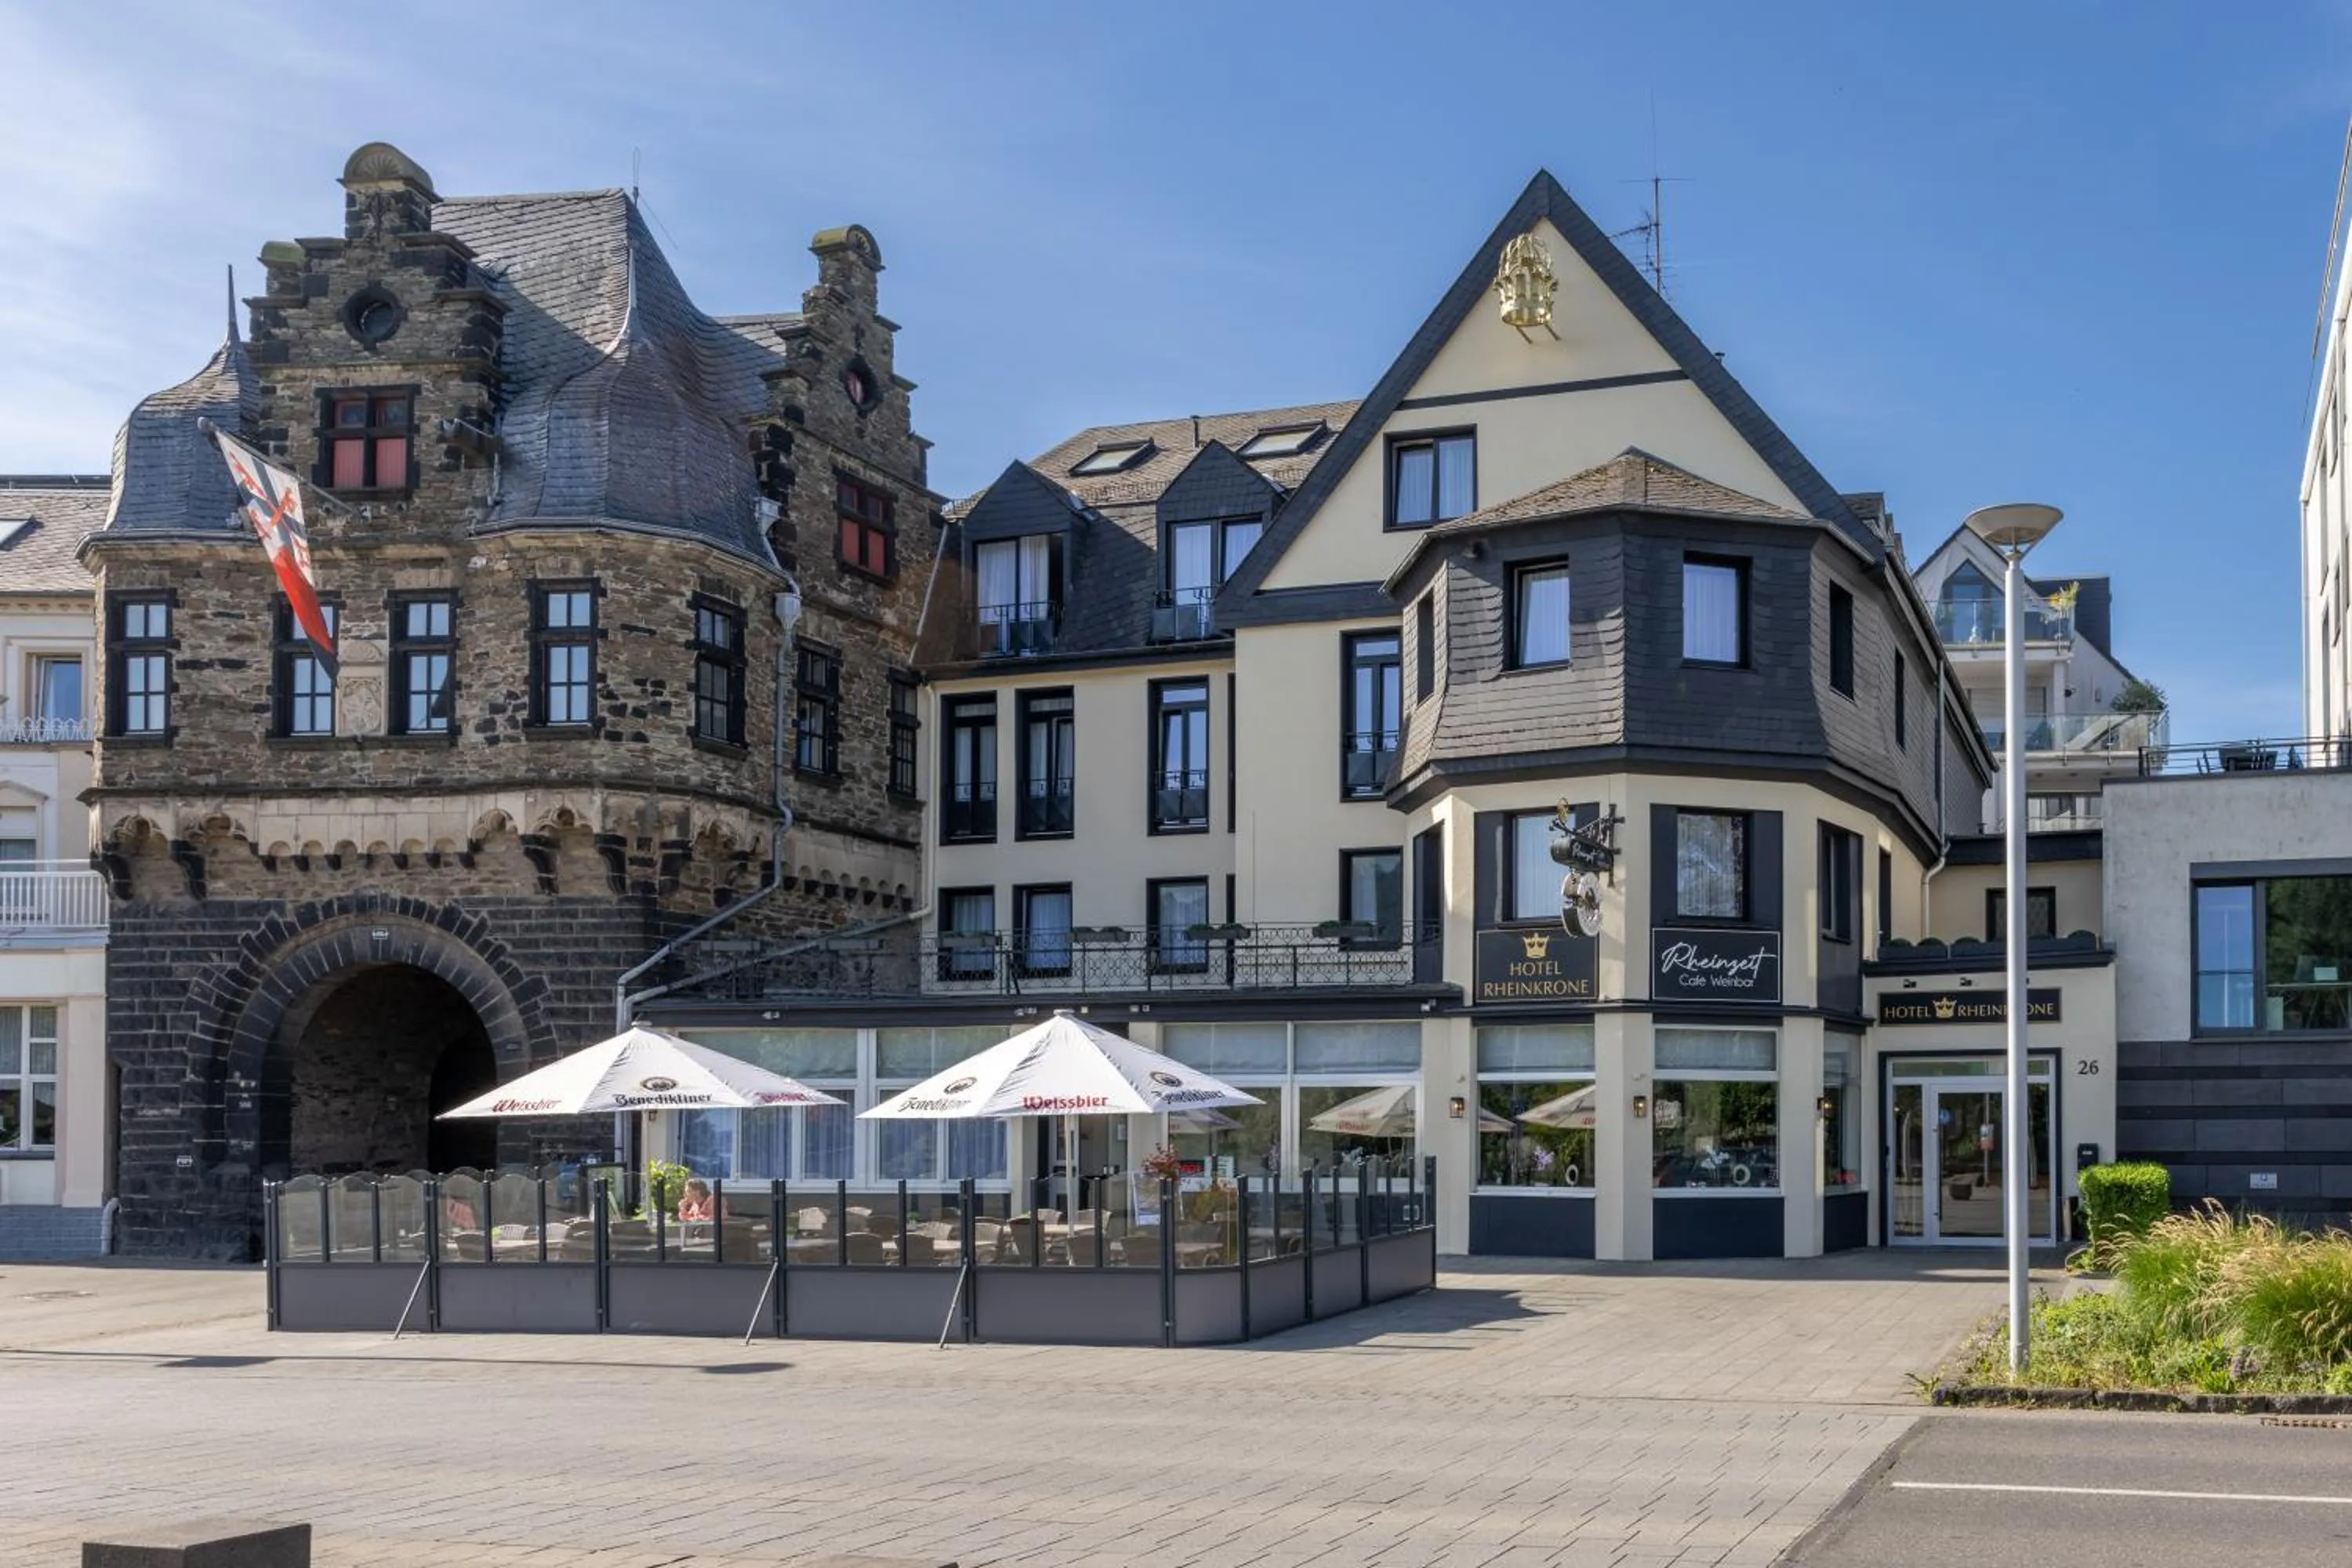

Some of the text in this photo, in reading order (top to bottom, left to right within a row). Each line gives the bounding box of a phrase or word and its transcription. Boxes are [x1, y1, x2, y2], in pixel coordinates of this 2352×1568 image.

[1510, 960, 1562, 976] HOTEL
[1484, 979, 1590, 997] RHEINKRONE
[1710, 975, 1754, 988] Weinbar
[1884, 1003, 2054, 1018] HOTEL RHEINONE
[2078, 1059, 2099, 1075] 26
[612, 1093, 712, 1107] Benediktiner
[1022, 1095, 1109, 1109] Weissbier
